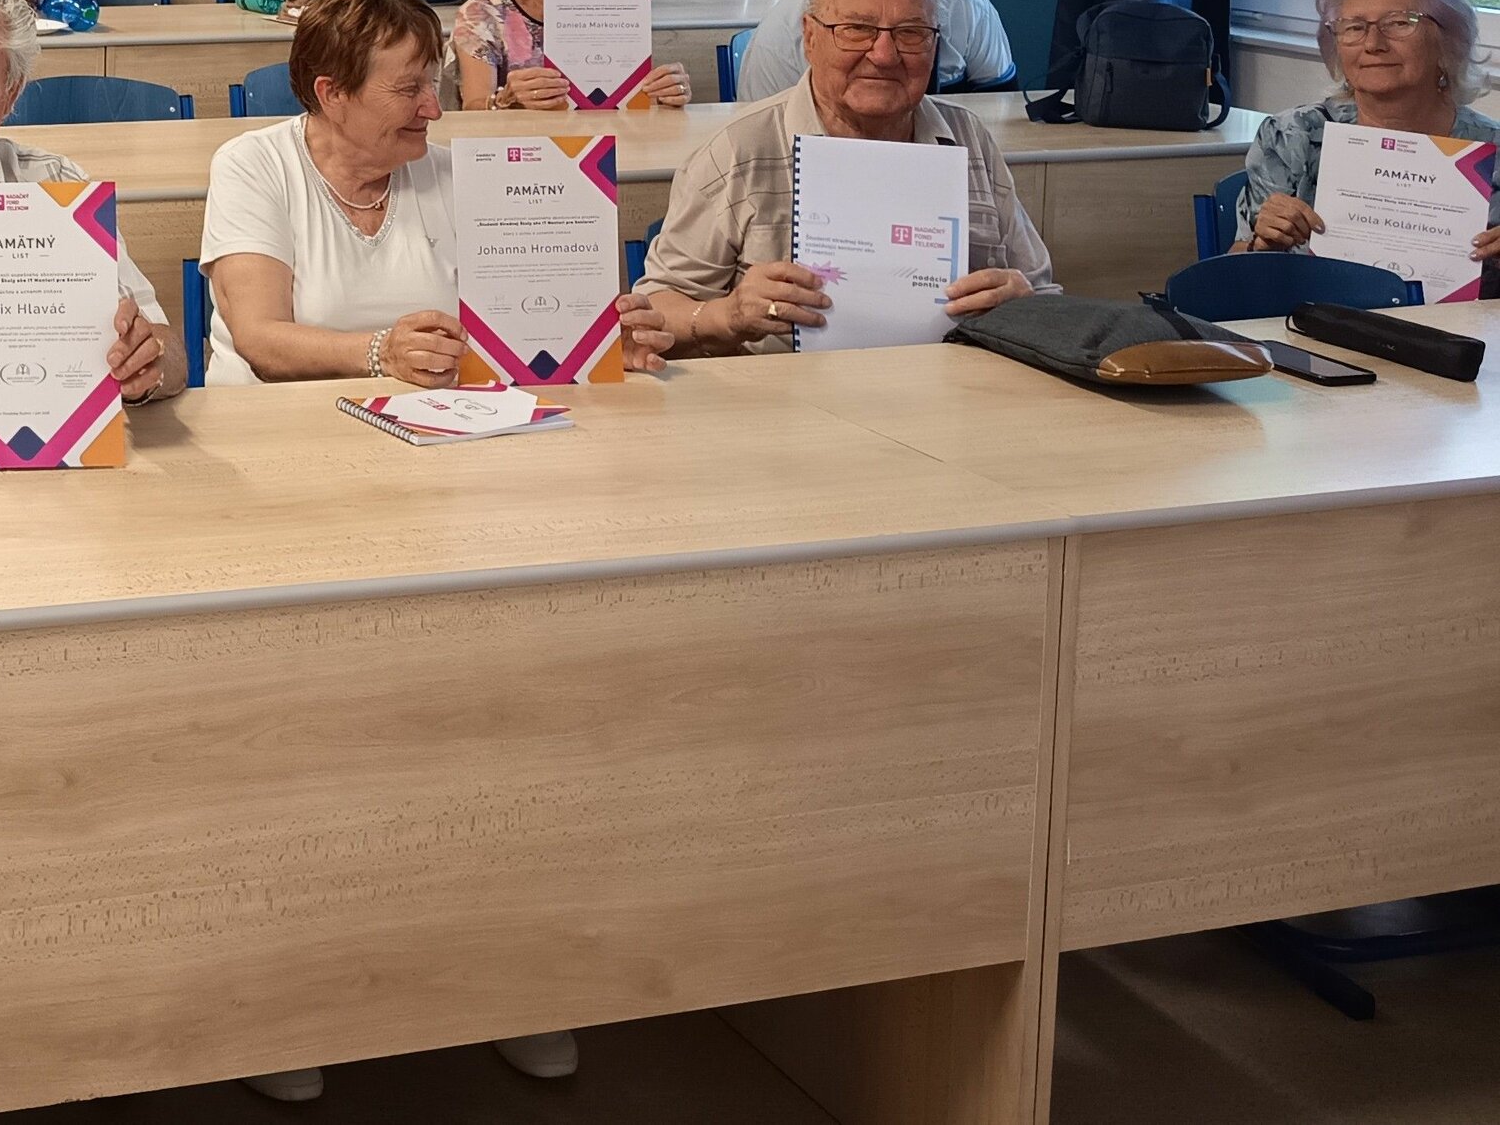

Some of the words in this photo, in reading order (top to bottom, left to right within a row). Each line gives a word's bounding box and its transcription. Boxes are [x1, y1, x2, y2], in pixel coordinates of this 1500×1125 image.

[1374, 168, 1437, 185] PAMÄTNÝ
[506, 182, 565, 196] PAMÄTNÝ
[1348, 212, 1380, 225] Viola
[477, 245, 527, 256] Johanna
[531, 243, 599, 254] Hromadová
[914, 240, 945, 249] TELEKOM
[912, 274, 947, 283] nadácia
[912, 281, 940, 289] pontis
[18, 303, 66, 315] Hlaváč
